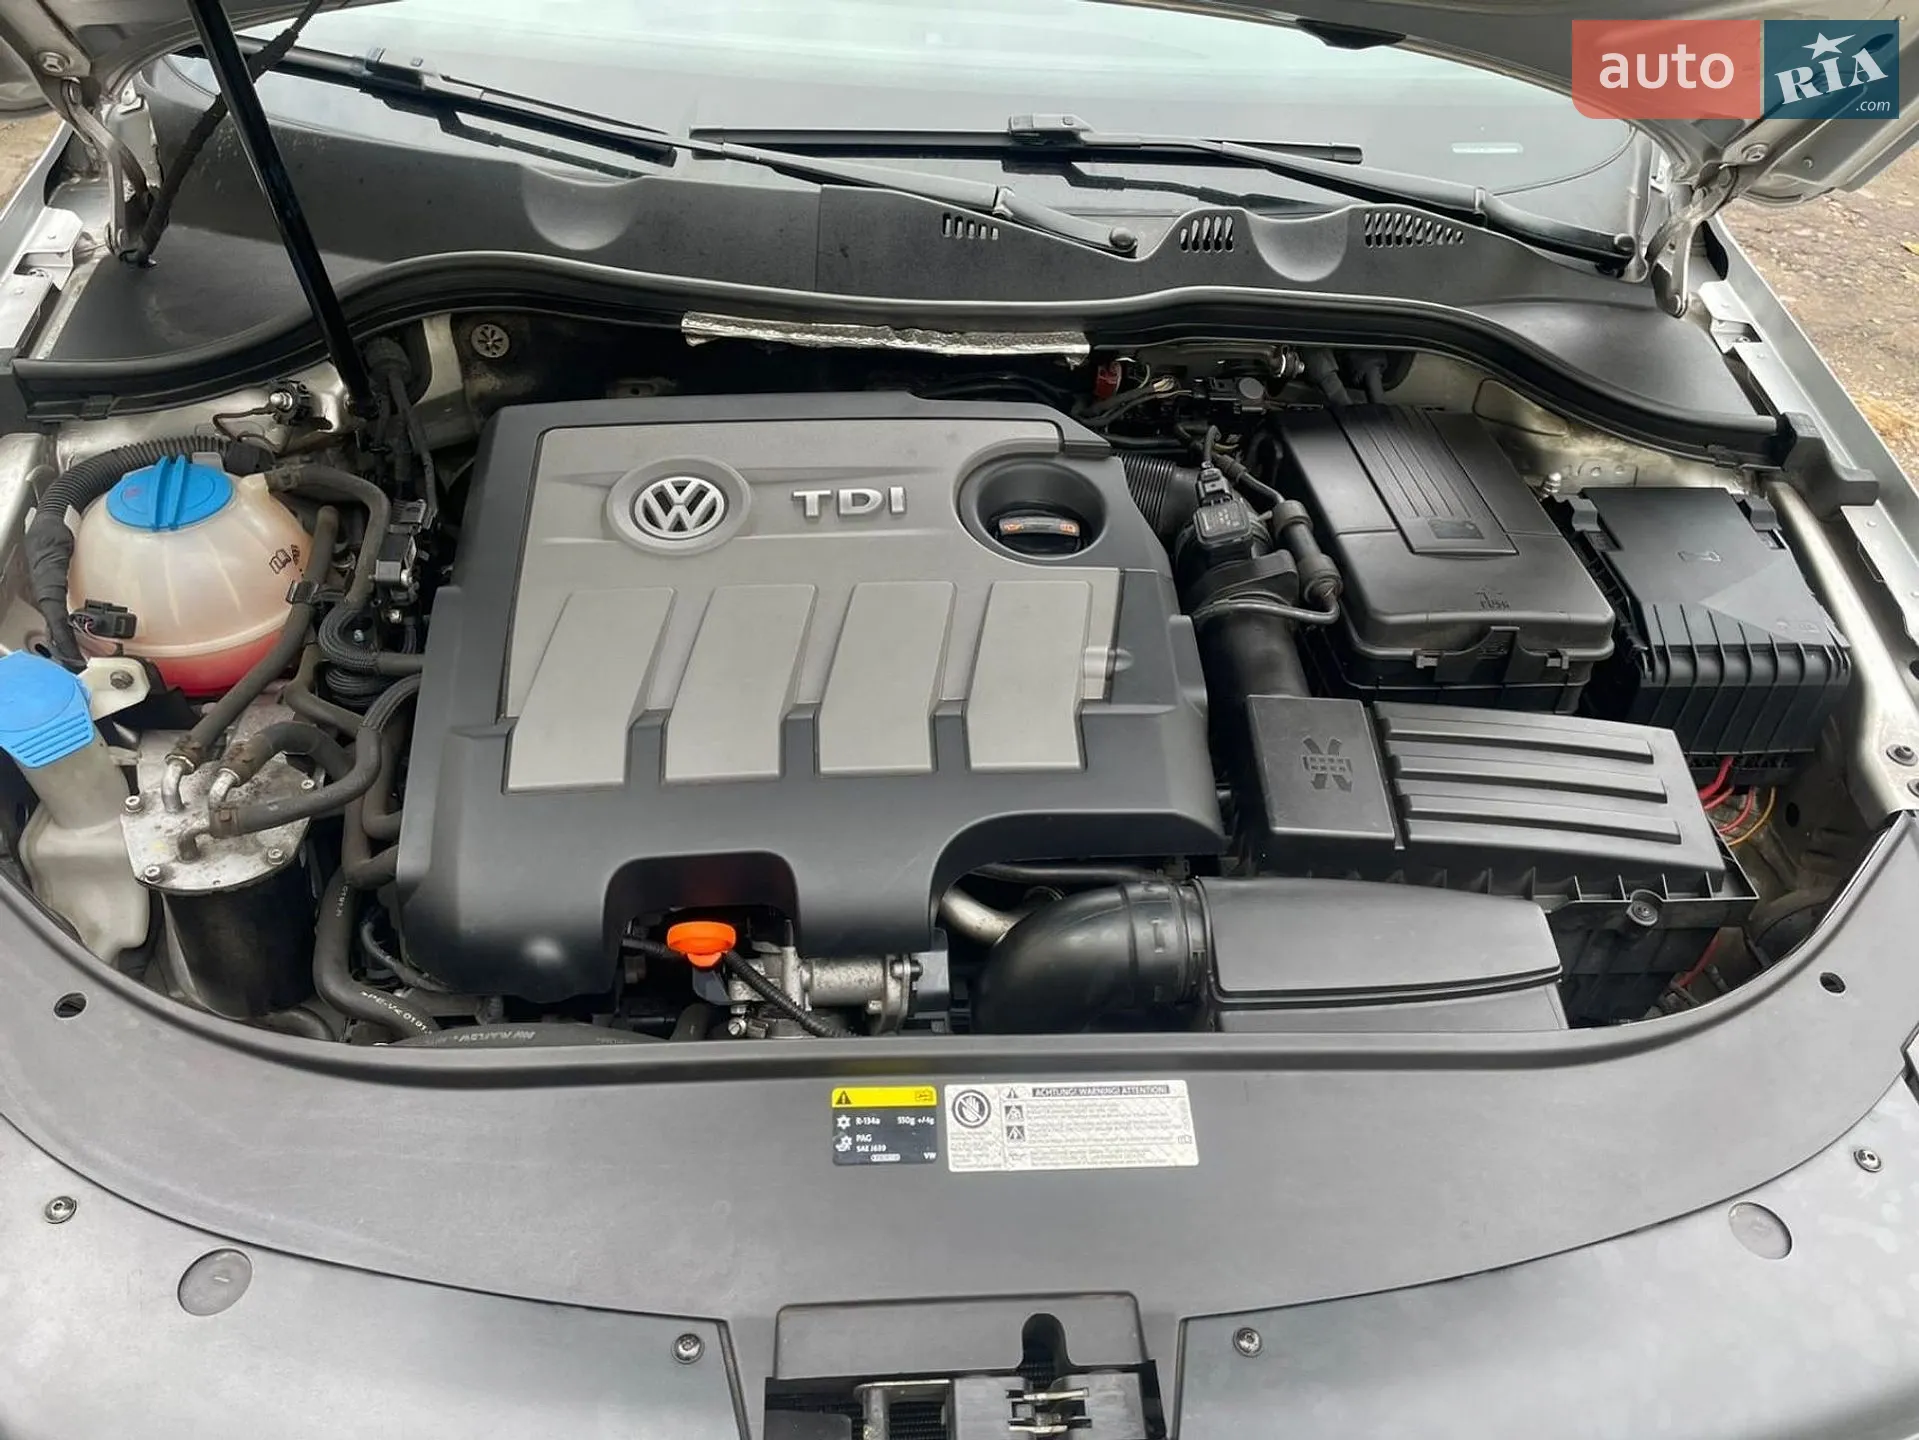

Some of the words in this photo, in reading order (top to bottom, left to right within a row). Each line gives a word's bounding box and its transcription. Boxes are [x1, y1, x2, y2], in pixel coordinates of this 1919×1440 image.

[792, 486, 905, 518] TDI
[1079, 1087, 1120, 1096] WARNING!
[855, 1134, 872, 1142] PAG
